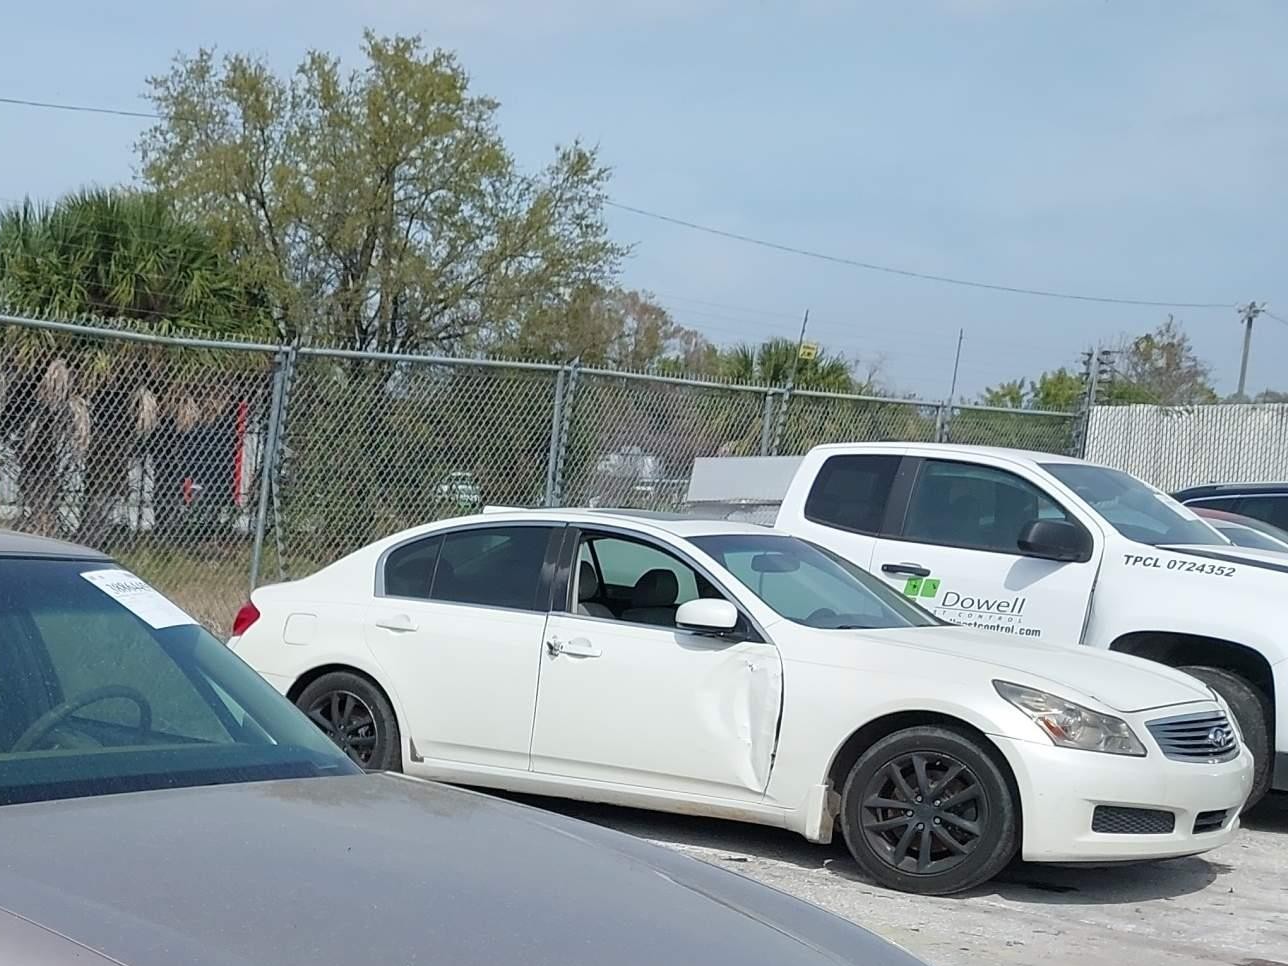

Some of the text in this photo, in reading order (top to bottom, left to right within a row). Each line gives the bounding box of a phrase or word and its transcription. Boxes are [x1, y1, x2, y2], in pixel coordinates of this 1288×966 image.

[1123, 554, 1237, 577] TPCL 0724352
[941, 591, 1026, 614] Dowell
